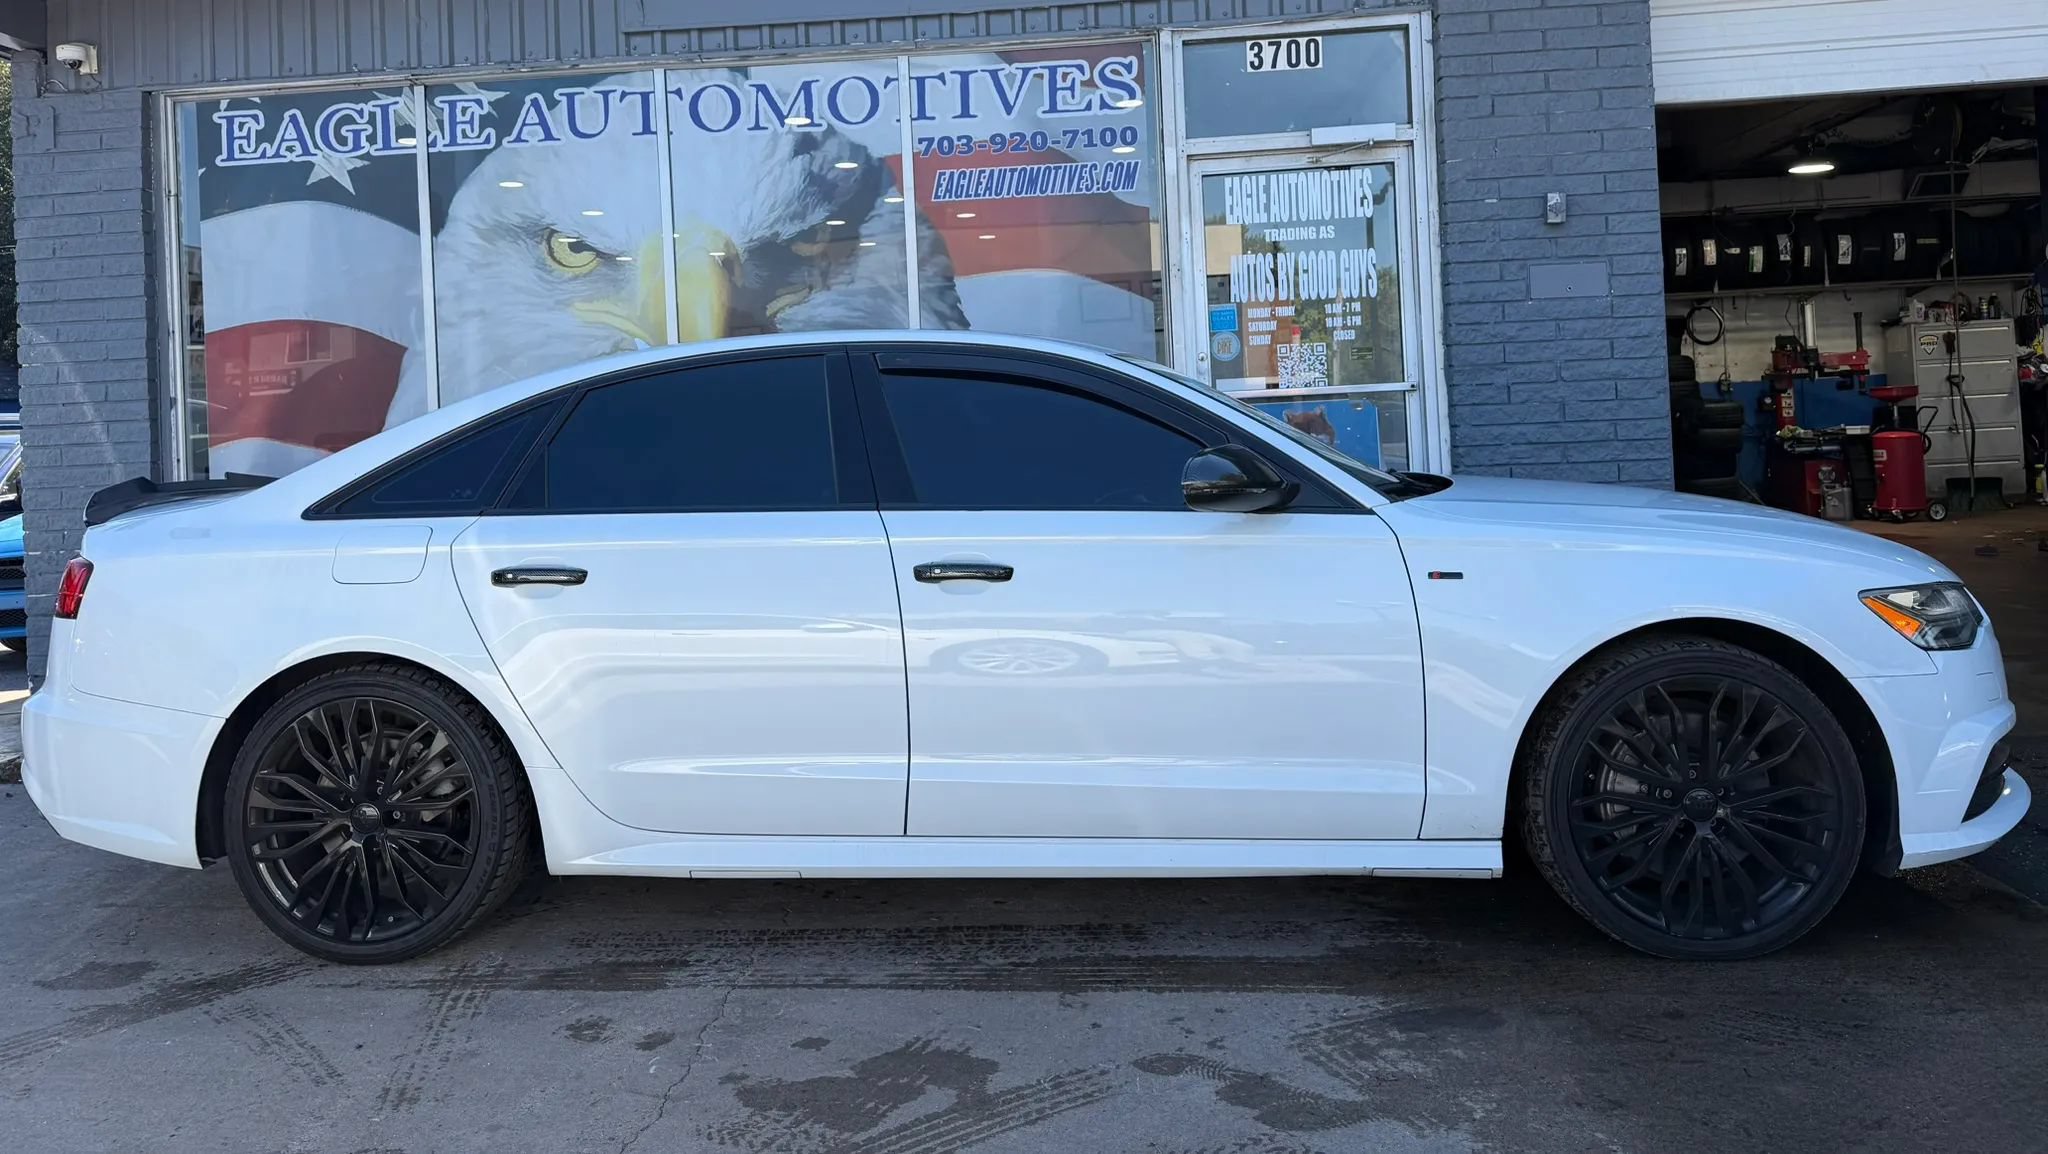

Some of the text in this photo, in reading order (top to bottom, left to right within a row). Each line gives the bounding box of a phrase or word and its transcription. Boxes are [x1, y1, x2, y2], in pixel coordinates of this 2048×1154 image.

[1249, 38, 1320, 70] 3700
[218, 58, 1140, 164] EAGLE AUTOMOTIVES
[917, 125, 1139, 158] 703-920-7100
[932, 161, 1140, 200] EAGLEAUTOMOTIVES.COM
[1224, 168, 1374, 225] EAGLE AUTOMOTIVES
[1264, 224, 1335, 241] TRADING AS
[1231, 248, 1377, 303] AUTOS BY GOOD GUYS
[1247, 305, 1296, 318] MONDAY FRIDAY
[1248, 320, 1277, 332] SATURDAY
[1248, 334, 1271, 346] SUNDAY
[1333, 329, 1356, 341] CLOSED
